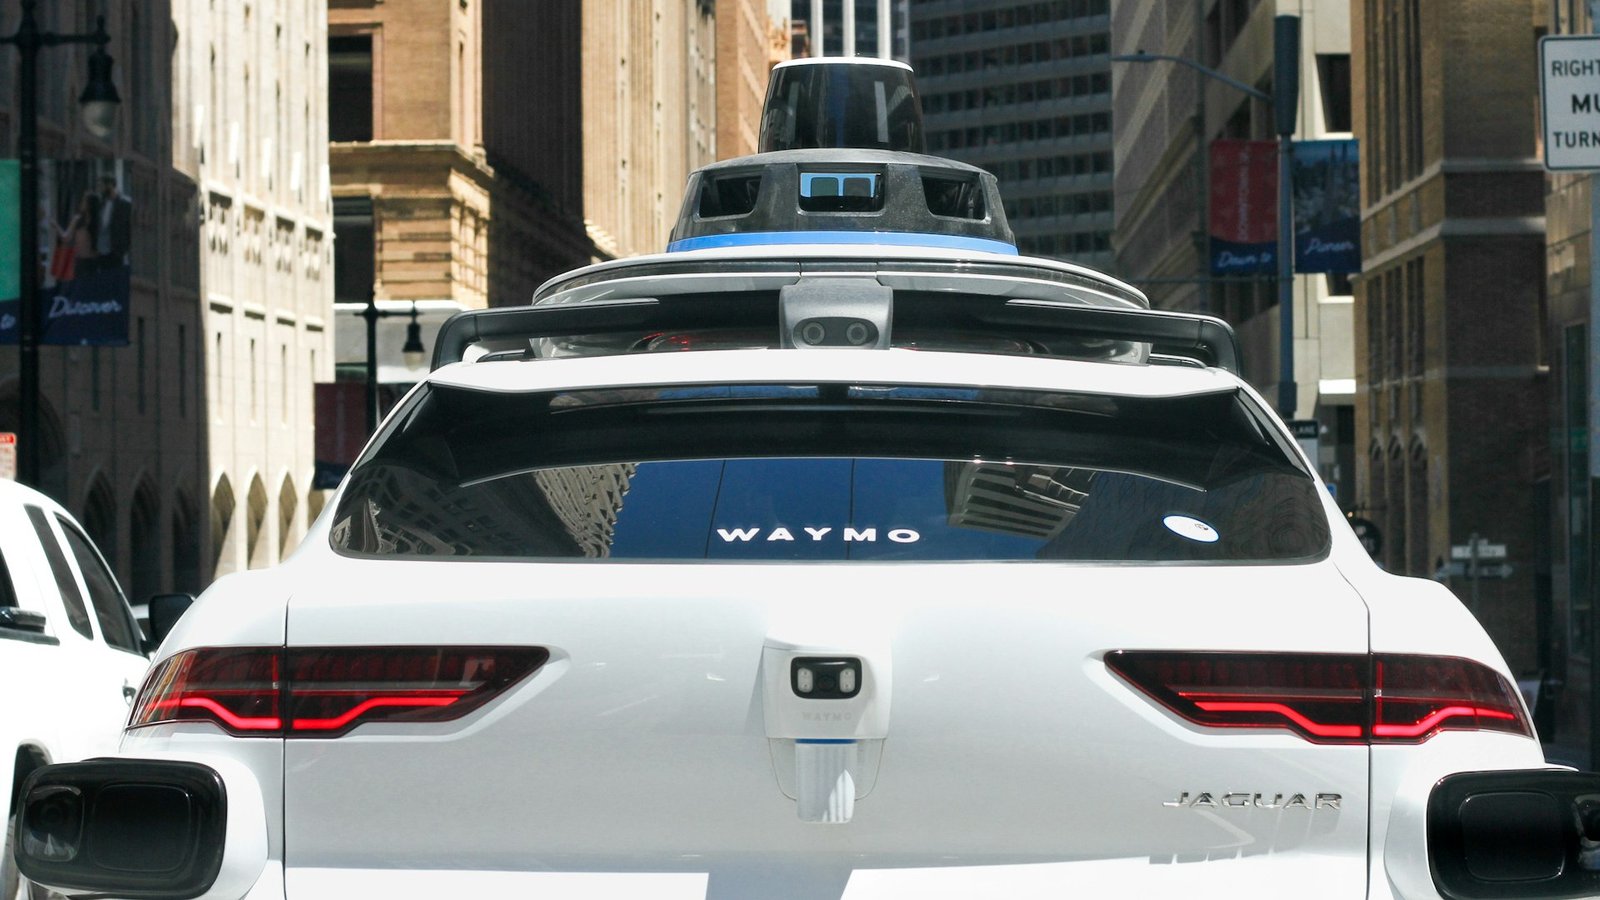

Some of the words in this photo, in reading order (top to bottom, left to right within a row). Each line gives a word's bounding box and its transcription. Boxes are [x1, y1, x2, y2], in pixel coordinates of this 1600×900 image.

[1553, 131, 1600, 148] TURN
[1217, 251, 1257, 268] Down
[48, 296, 122, 318] Discover
[716, 527, 920, 543] WAYMO
[802, 711, 852, 721] WAYMO
[1162, 792, 1343, 810] JAGUAR
